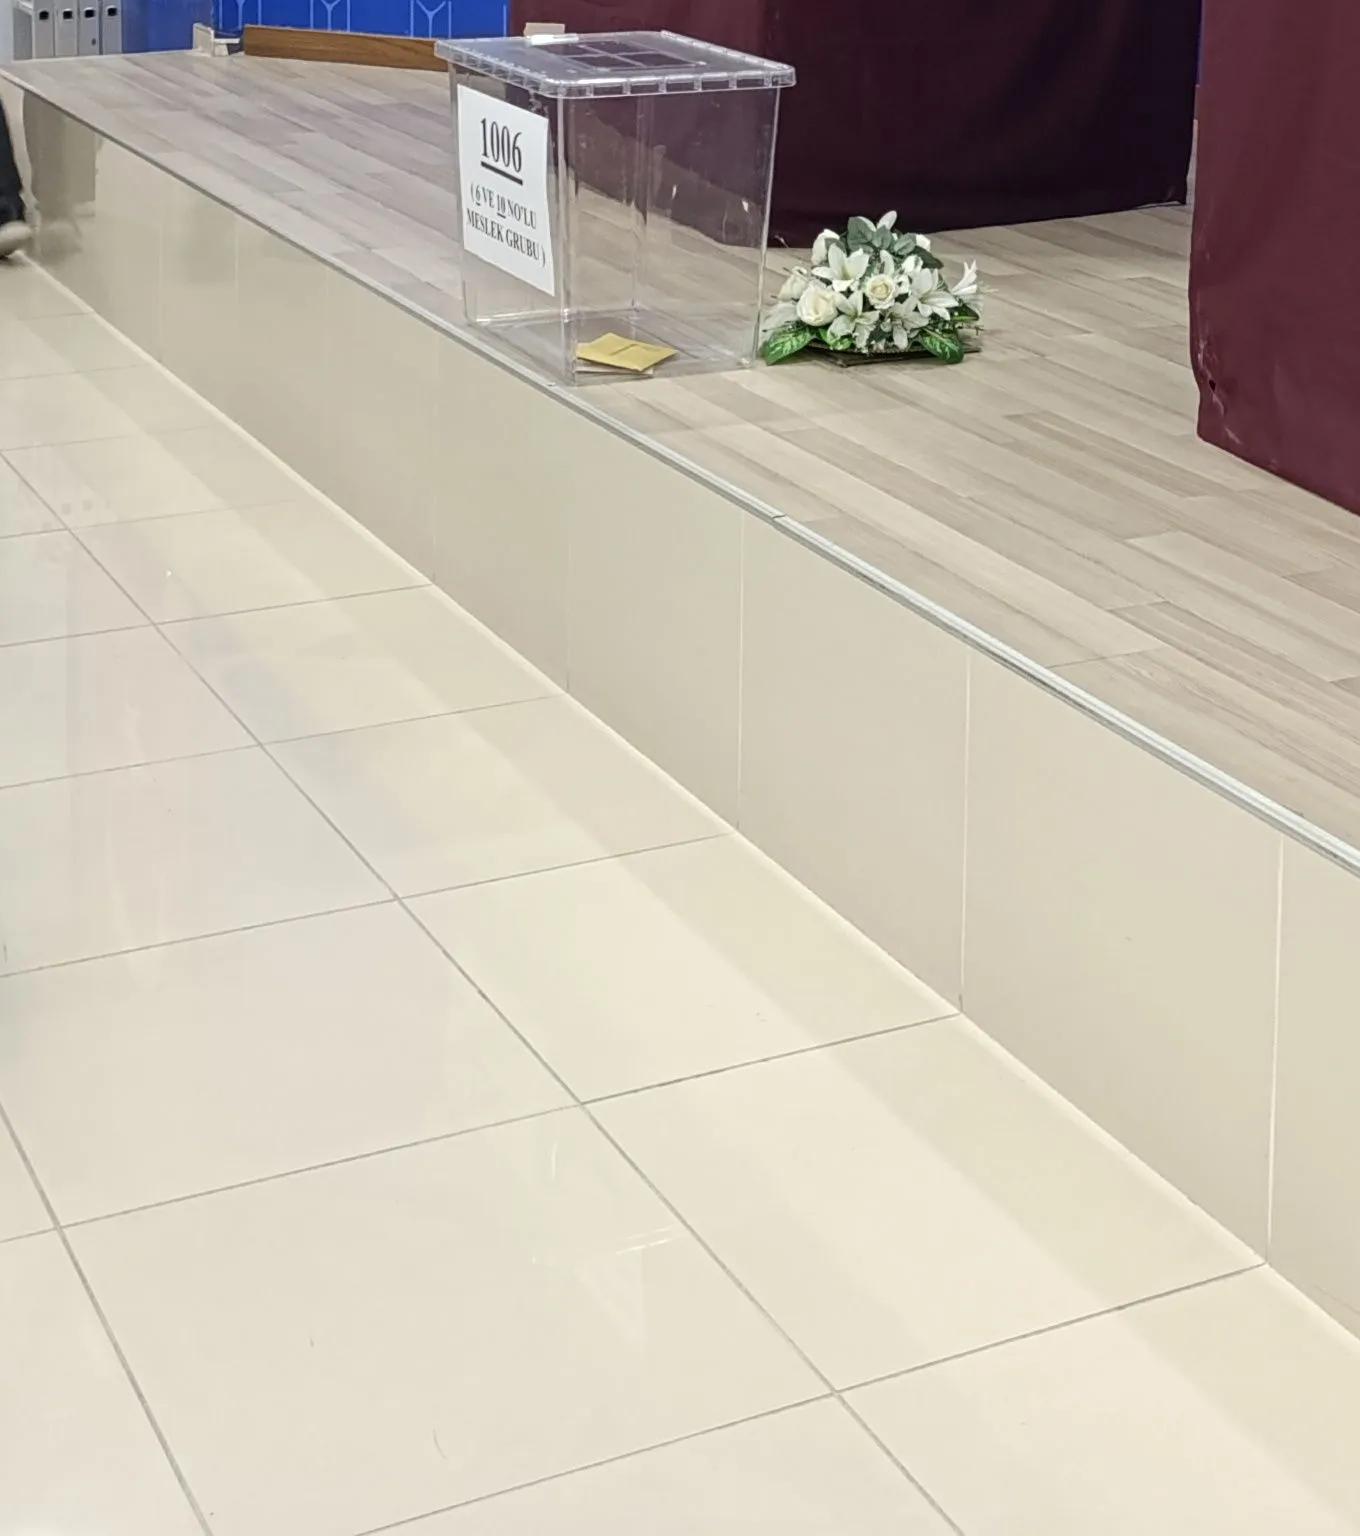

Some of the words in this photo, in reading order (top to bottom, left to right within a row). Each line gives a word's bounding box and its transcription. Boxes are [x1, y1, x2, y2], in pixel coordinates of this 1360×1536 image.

[480, 117, 523, 173] 1006
[467, 208, 504, 244] MESLEK
[482, 187, 495, 209] VE
[496, 194, 506, 215] 10
[507, 198, 537, 230] NO'LU
